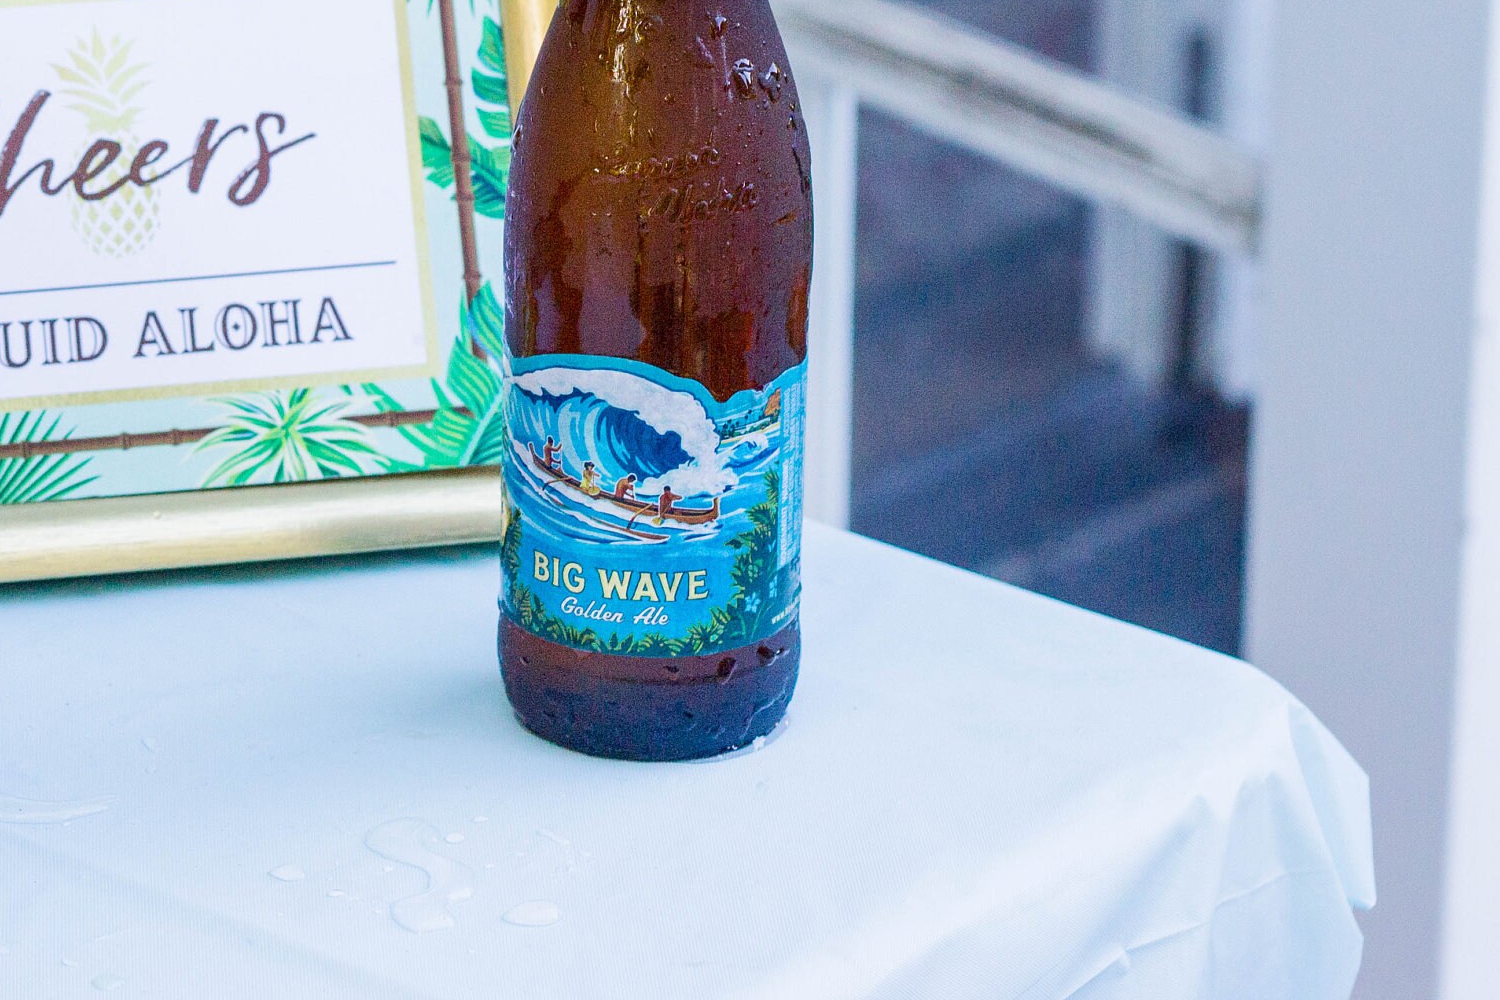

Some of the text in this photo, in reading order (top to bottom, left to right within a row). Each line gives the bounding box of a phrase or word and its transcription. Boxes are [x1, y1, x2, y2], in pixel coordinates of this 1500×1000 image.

[132, 296, 354, 359] ALOHA
[533, 550, 710, 602] BIG WAVE
[560, 596, 670, 626] Golden Ale
